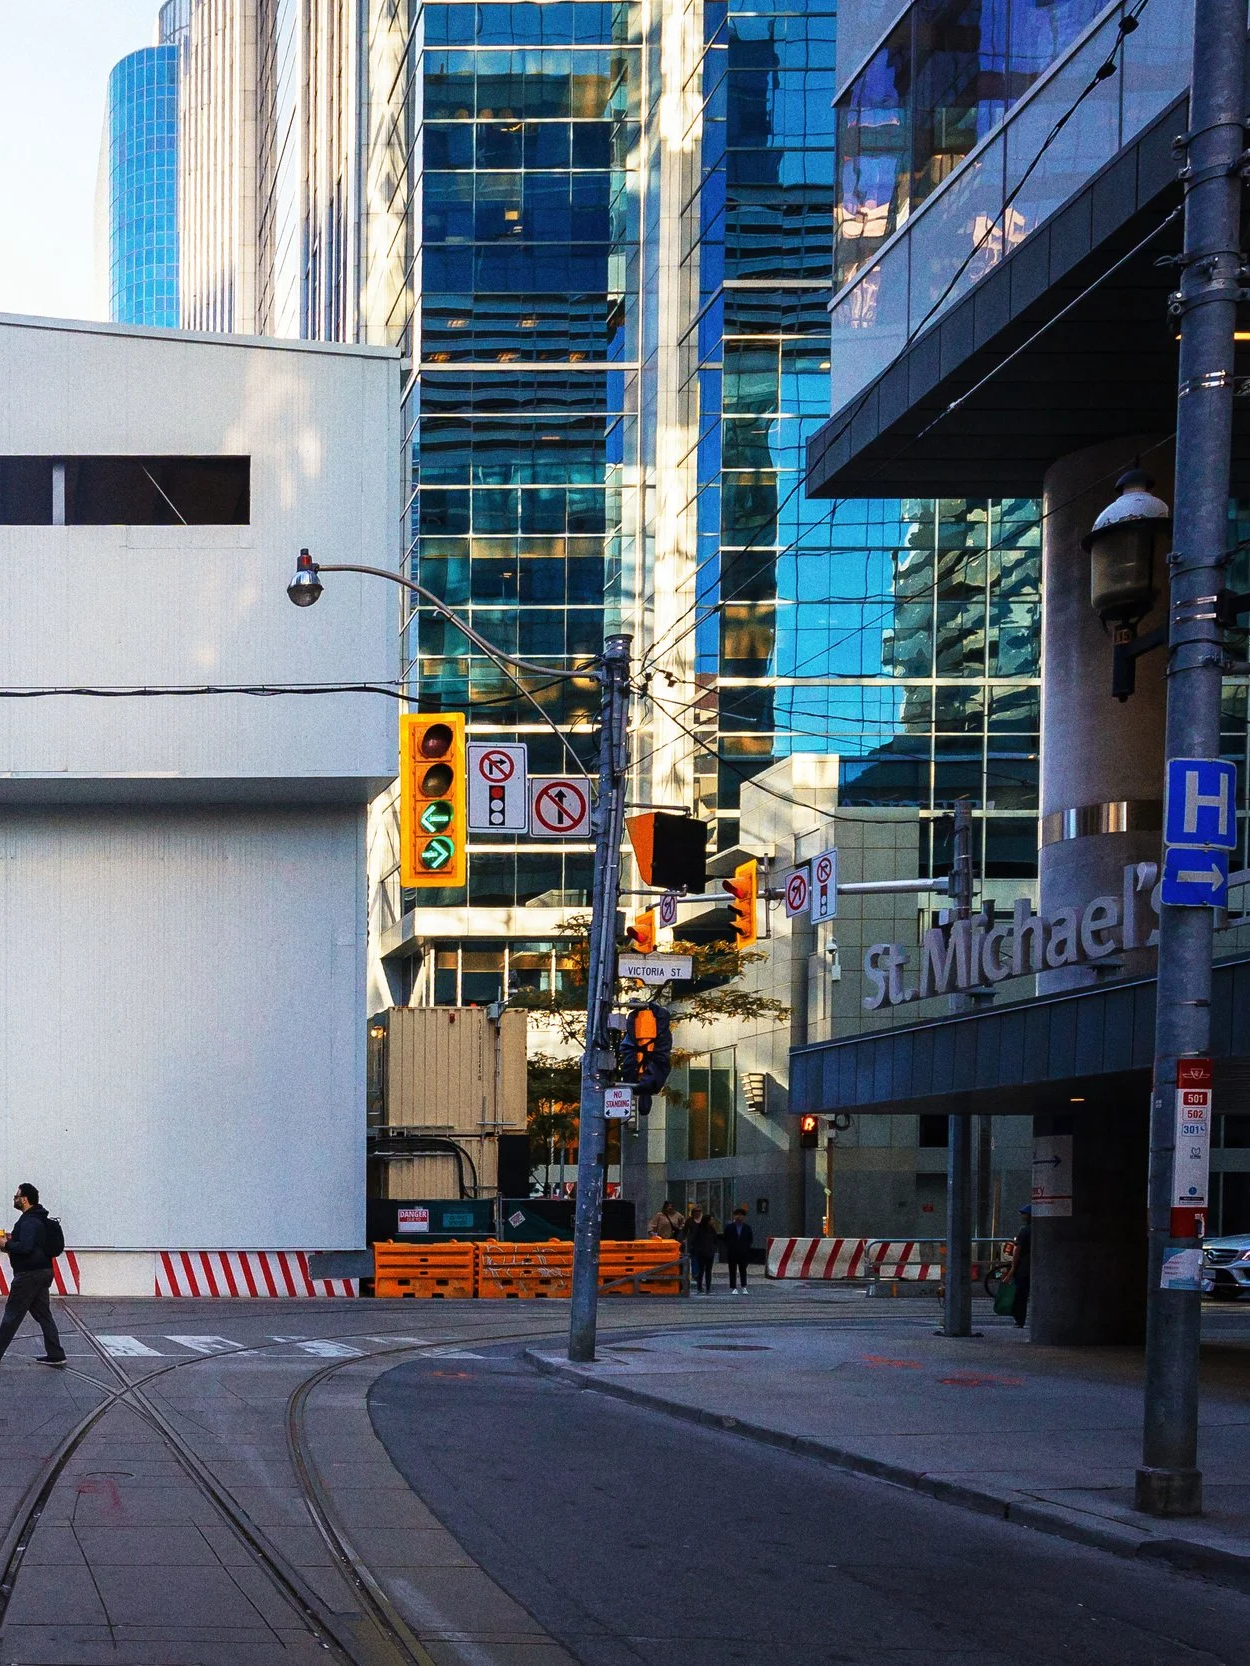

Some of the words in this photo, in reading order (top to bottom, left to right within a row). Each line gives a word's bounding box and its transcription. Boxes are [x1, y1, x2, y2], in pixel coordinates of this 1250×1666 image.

[1184, 771, 1229, 835] H
[628, 966, 665, 977] VICTORIA
[863, 943, 918, 1010] St.
[606, 1100, 630, 1108] STANDING
[1188, 1095, 1203, 1103] 501
[1187, 1109, 1203, 1119] 502
[1183, 1125, 1199, 1134] 301
